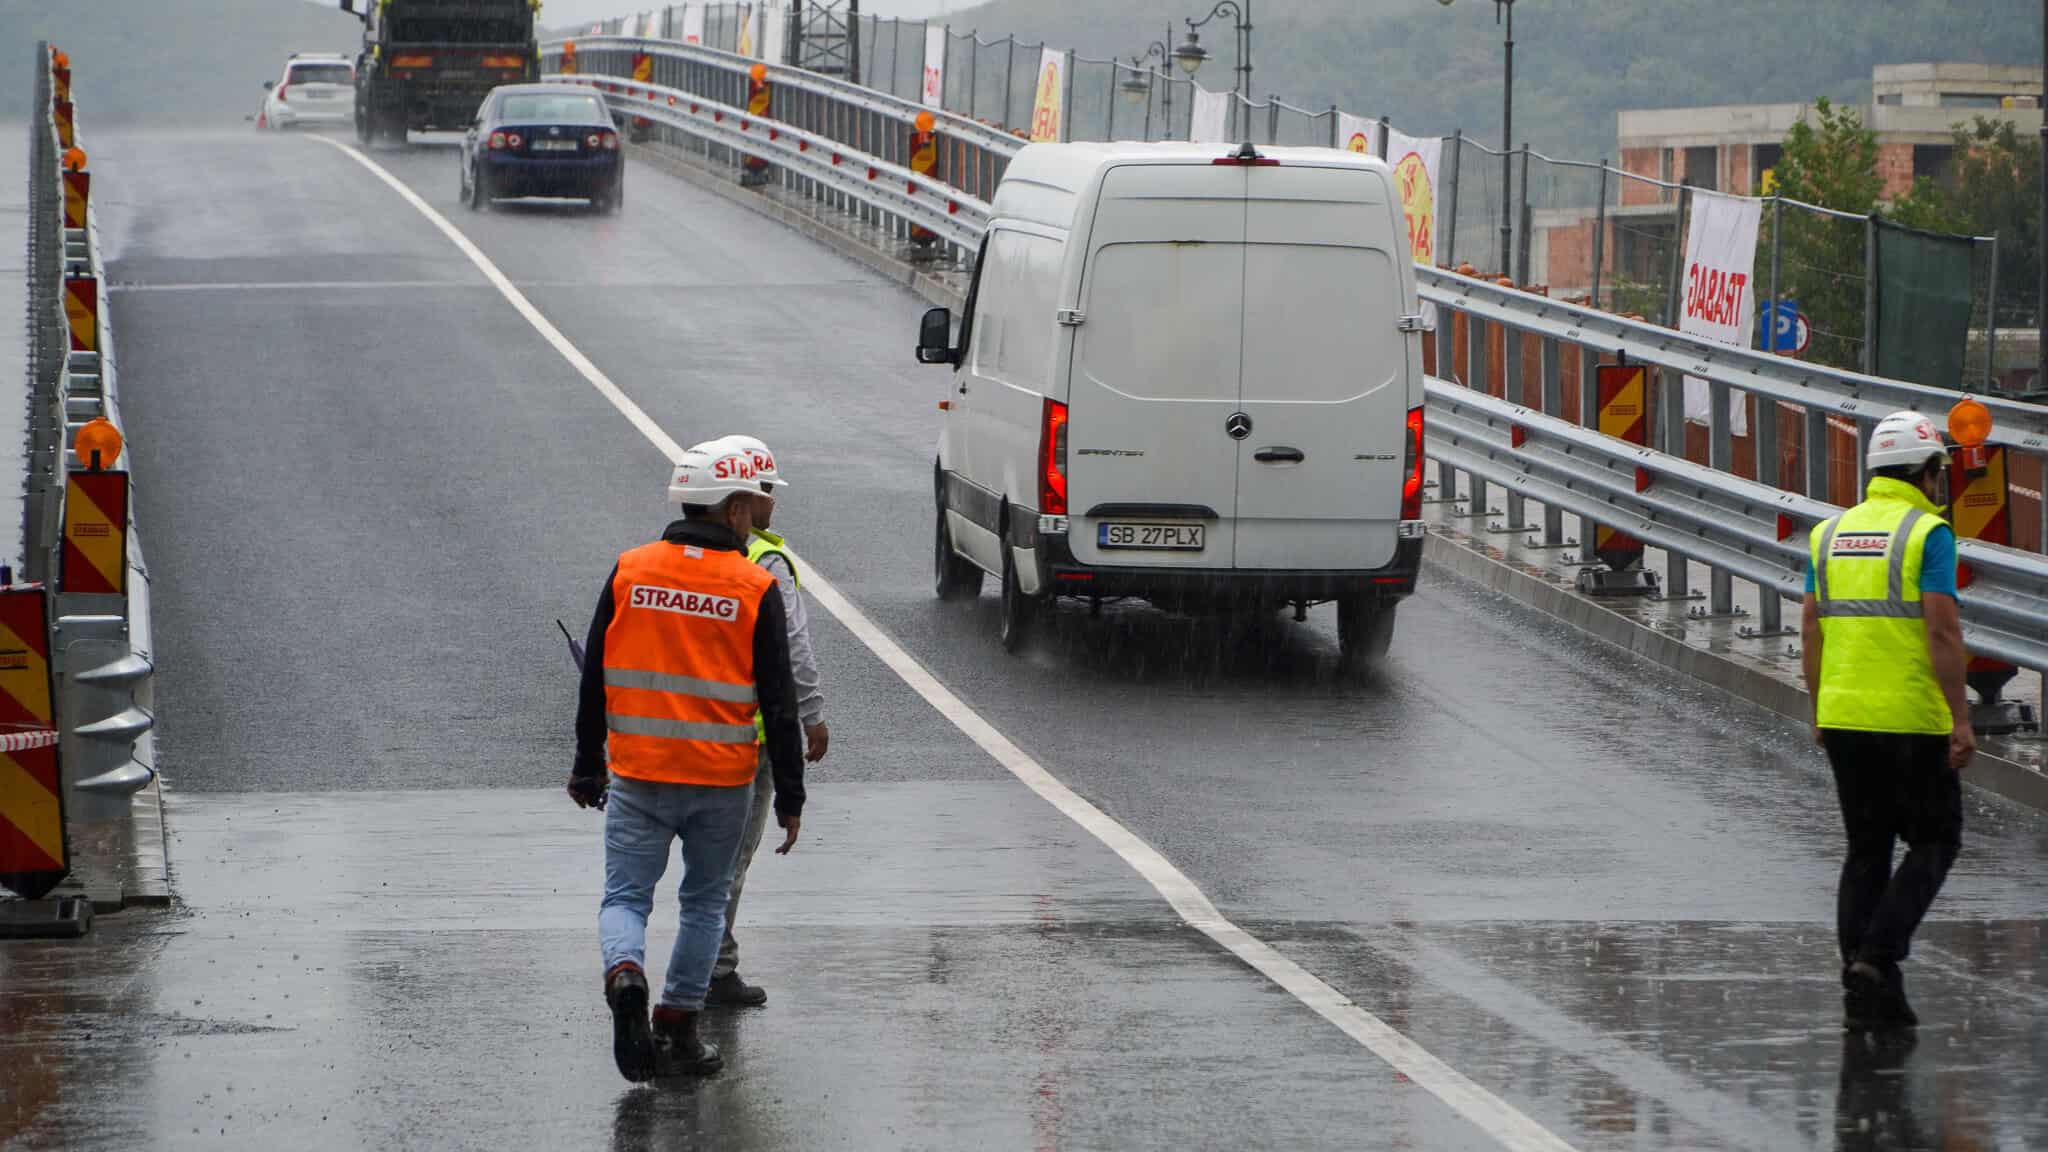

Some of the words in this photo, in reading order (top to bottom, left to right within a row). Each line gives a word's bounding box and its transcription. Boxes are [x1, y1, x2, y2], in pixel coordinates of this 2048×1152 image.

[1110, 526, 1135, 543] SB
[1832, 538, 1887, 549] STRABAG
[633, 588, 733, 617] STRABAG
